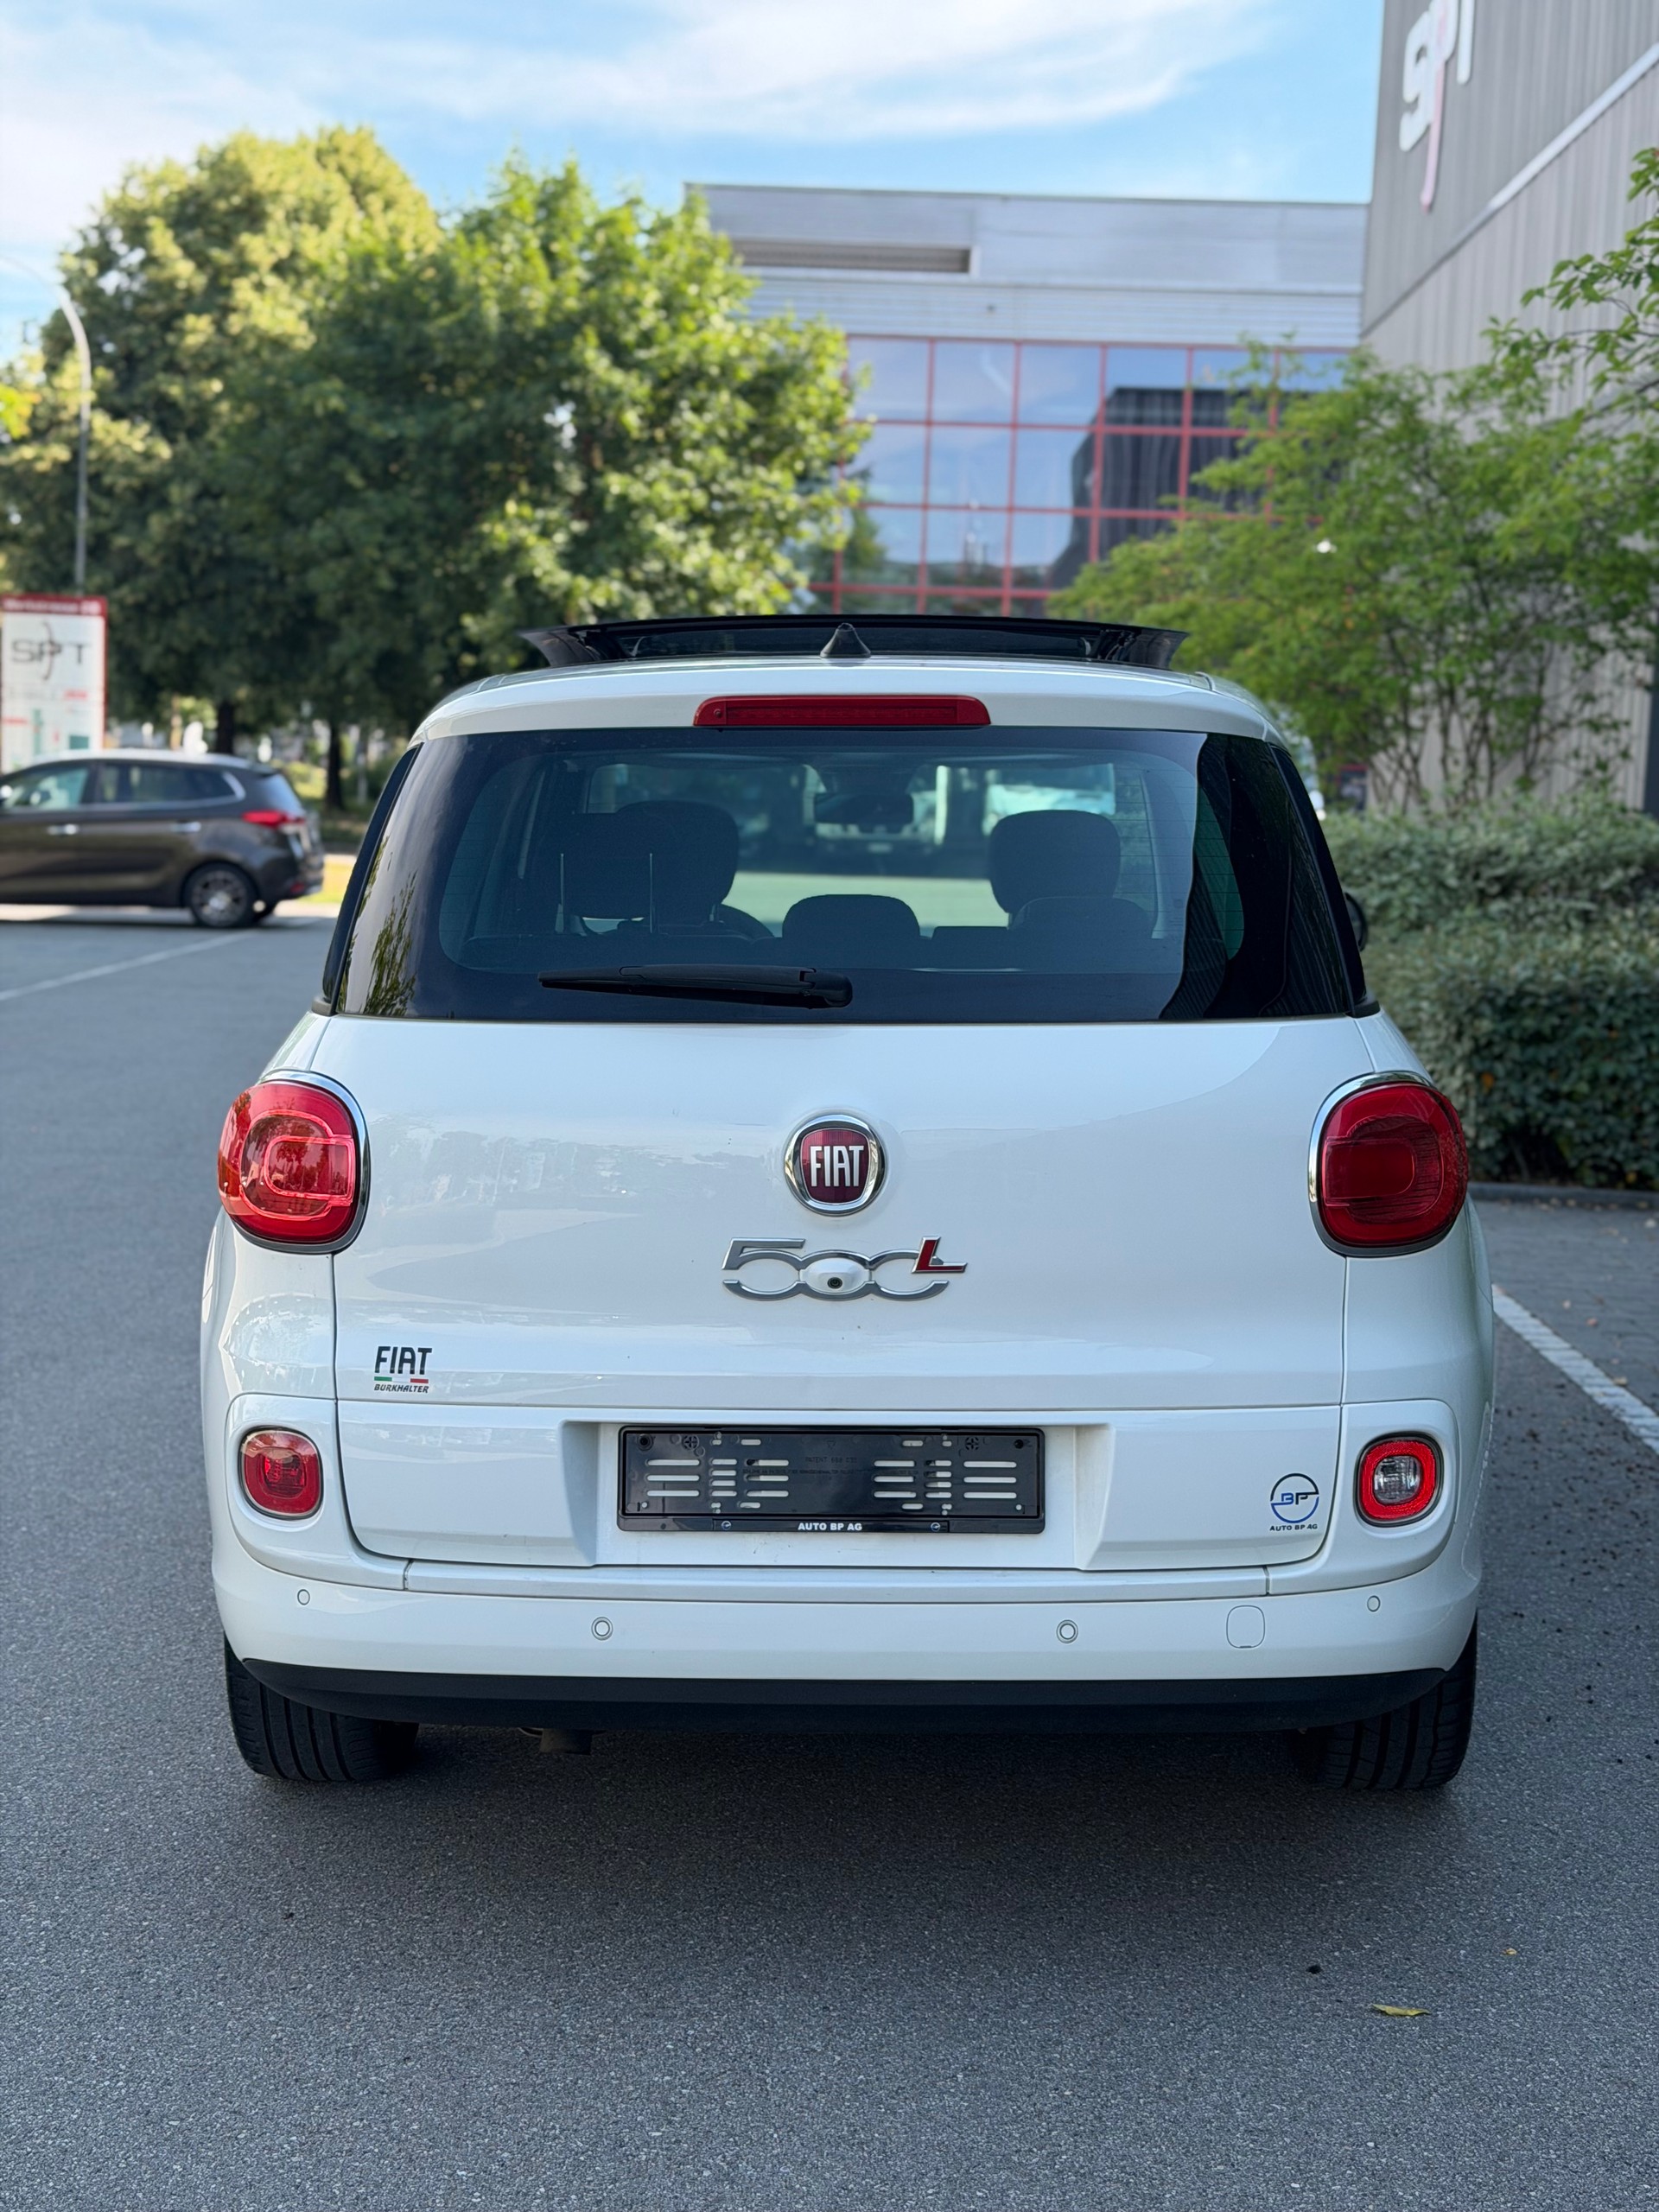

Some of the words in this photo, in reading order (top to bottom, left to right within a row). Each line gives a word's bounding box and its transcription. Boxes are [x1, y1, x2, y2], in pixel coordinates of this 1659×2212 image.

[810, 1145, 864, 1187] FIAT
[721, 1236, 968, 1301] 500L
[374, 1346, 433, 1375] FIAT
[374, 1384, 429, 1394] BURKHALTER
[1280, 1491, 1311, 1505] BP
[830, 1522, 844, 1531] BP
[847, 1522, 862, 1531] AG
